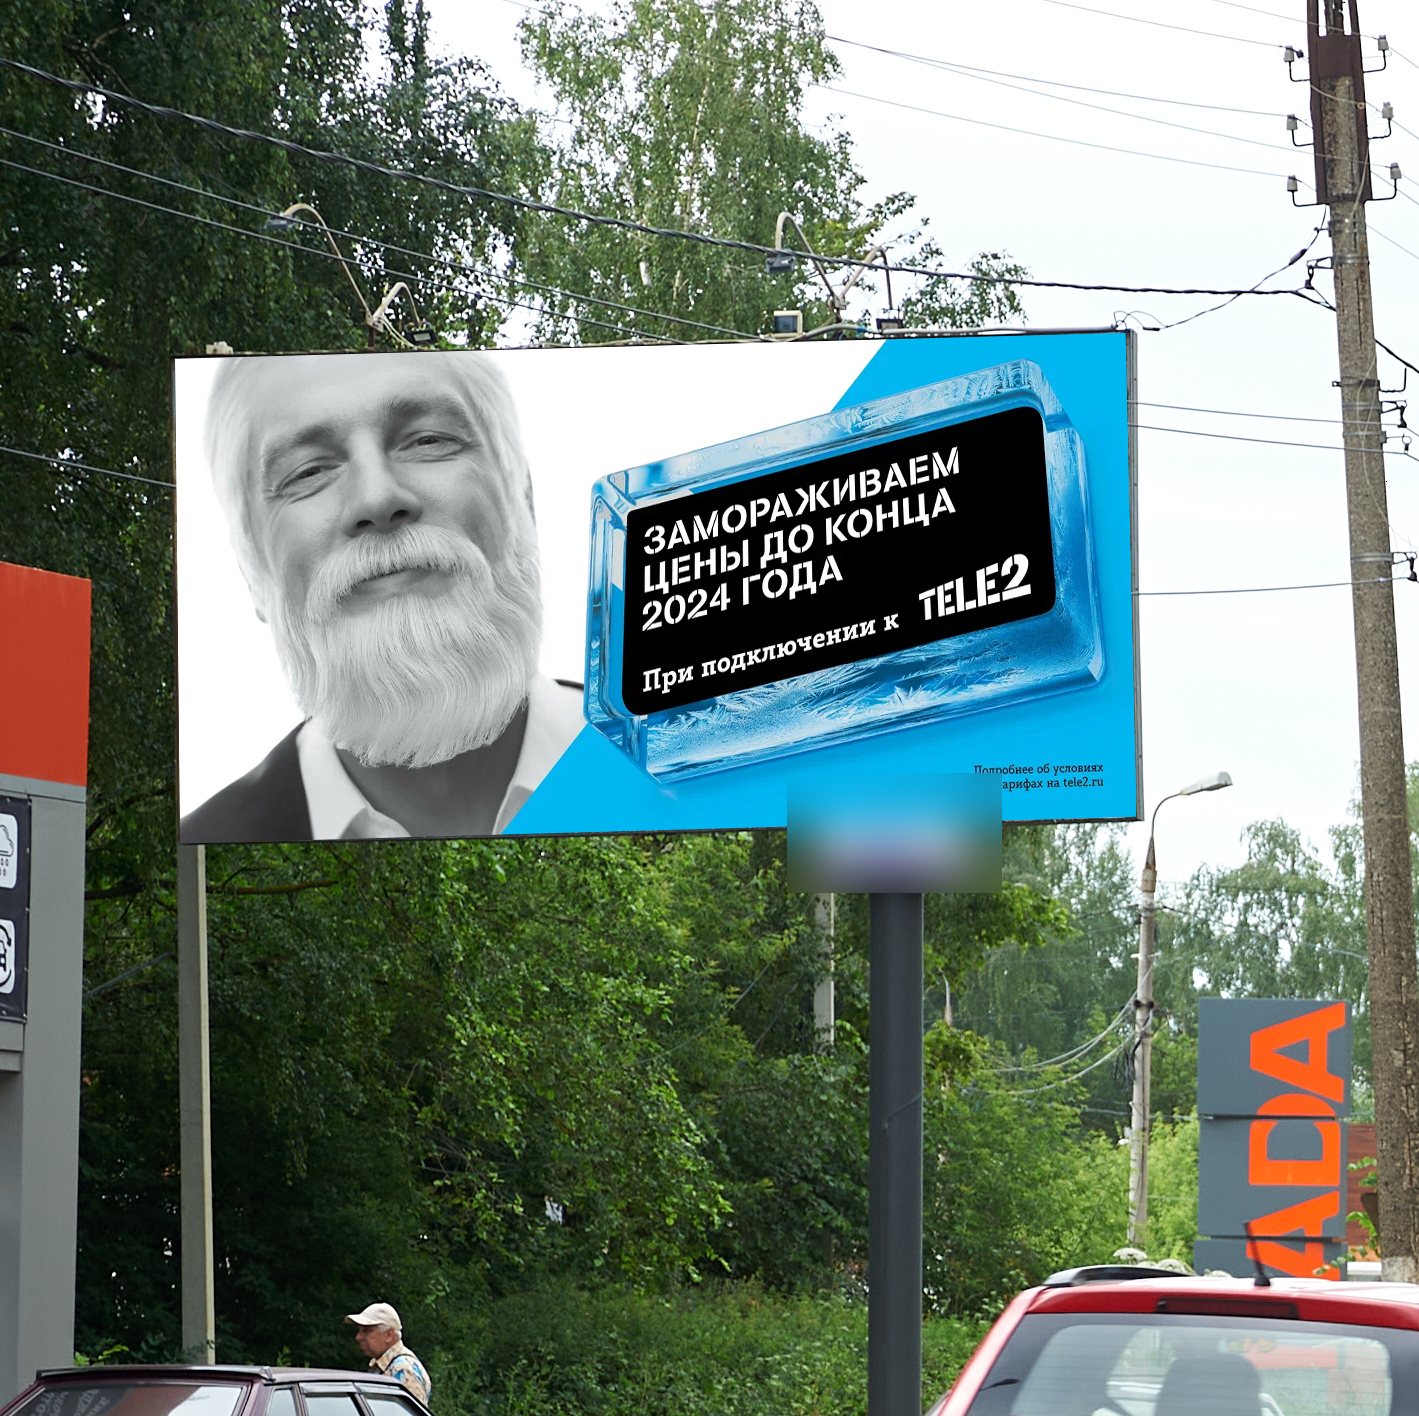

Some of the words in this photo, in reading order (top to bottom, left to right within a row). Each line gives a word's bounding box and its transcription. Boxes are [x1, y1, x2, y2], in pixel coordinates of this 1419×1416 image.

[644, 446, 960, 555] ЗАМОРАЖИВАЕМ
[644, 539, 749, 594] ЦЕНЫ
[760, 524, 814, 569] ДО
[825, 487, 956, 546] КОНЦА
[642, 582, 731, 632] 2024
[742, 555, 844, 606] ГОДА
[918, 553, 1032, 621] TELE2
[643, 666, 694, 695] При
[701, 618, 876, 678] подключении
[884, 613, 900, 632] к
[1002, 778, 1043, 792] арифах
[1047, 780, 1060, 788] на
[1063, 776, 1104, 788] tele2.ru
[1036, 763, 1050, 774] об
[1052, 764, 1104, 776] условиях
[1246, 1001, 1346, 1281] ADA
